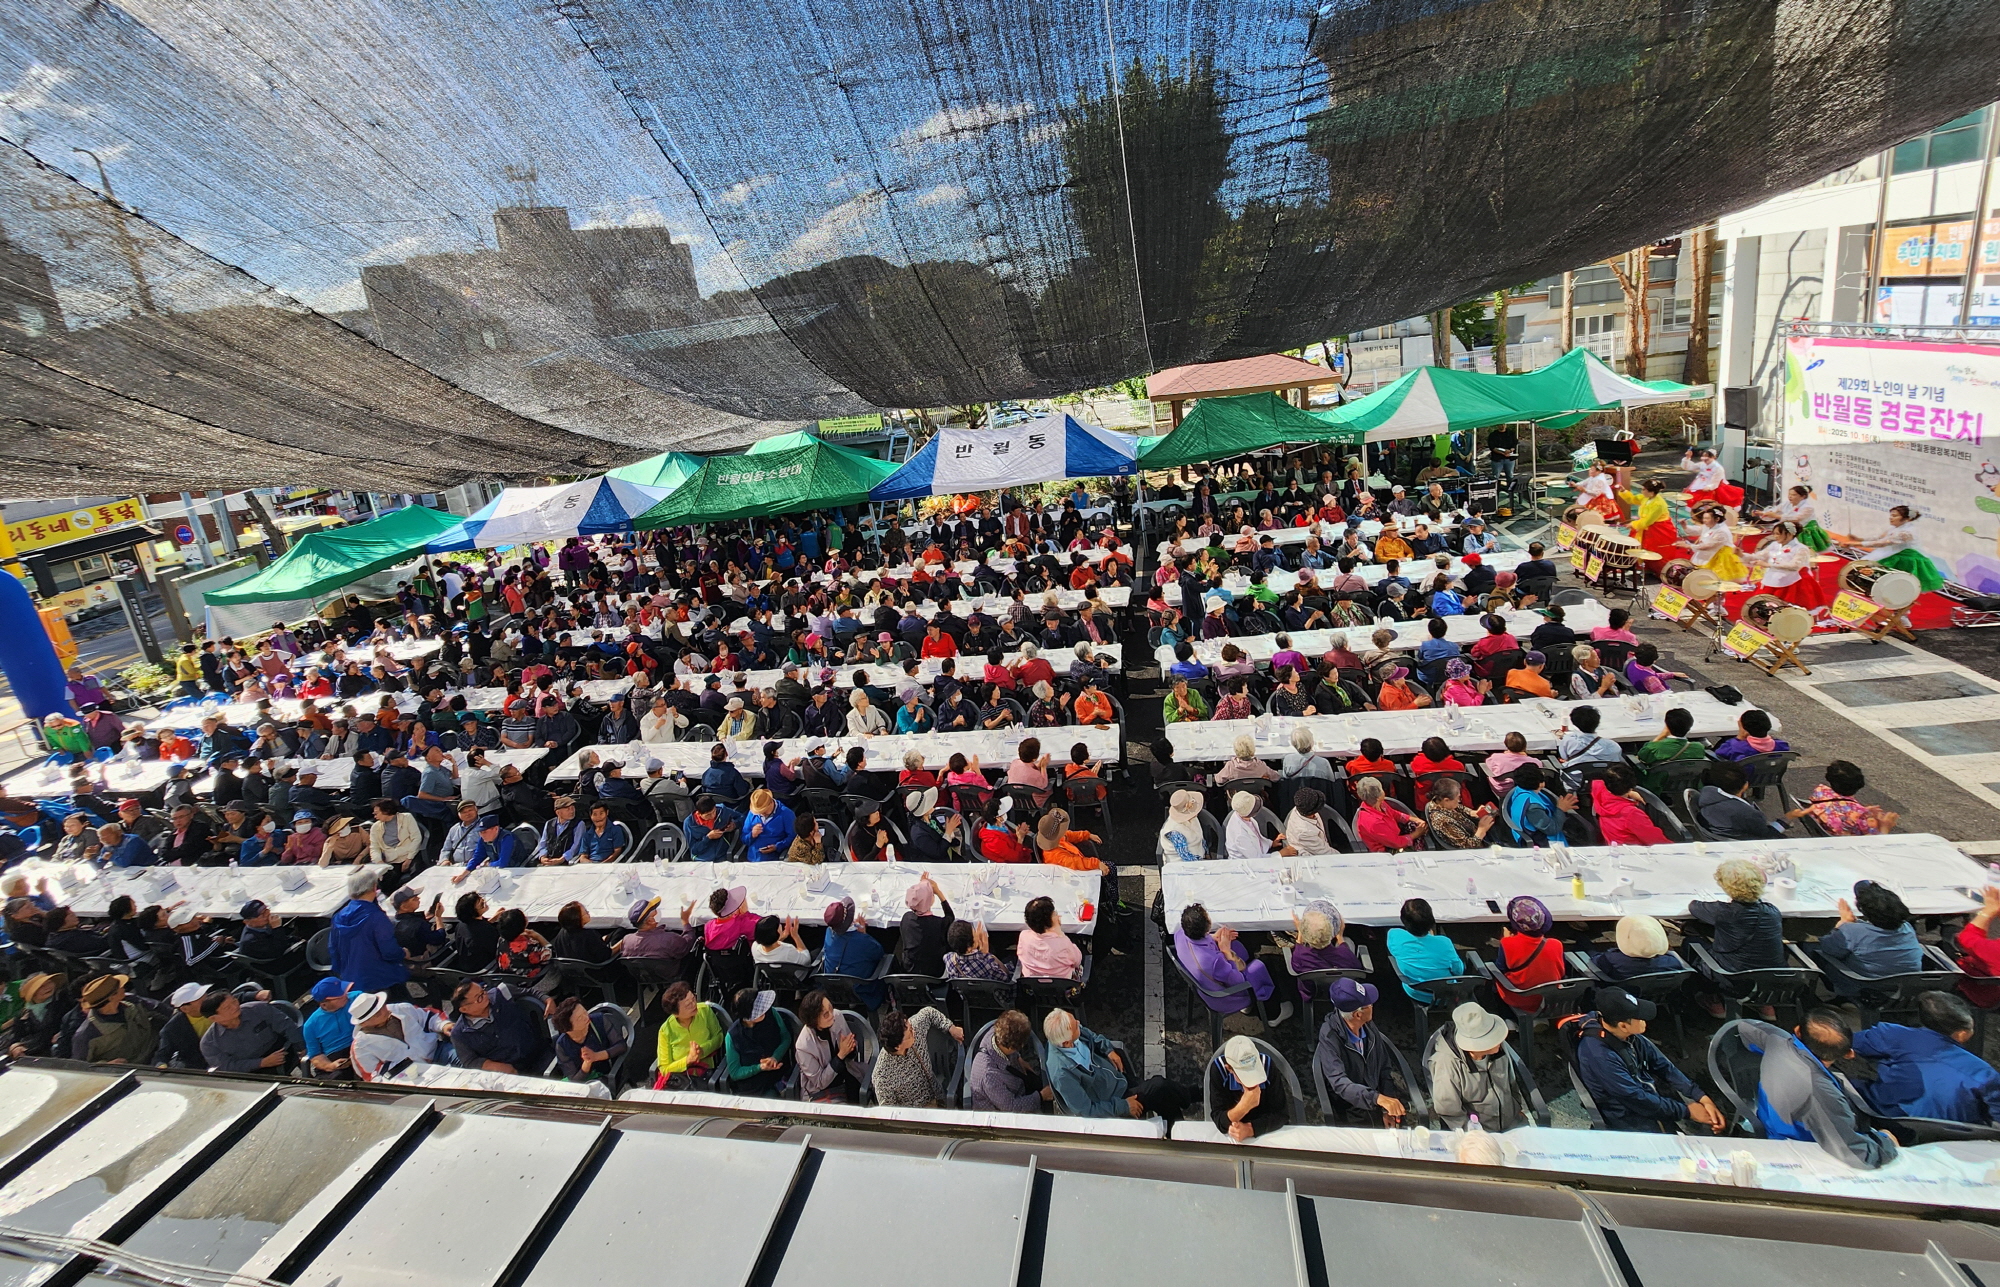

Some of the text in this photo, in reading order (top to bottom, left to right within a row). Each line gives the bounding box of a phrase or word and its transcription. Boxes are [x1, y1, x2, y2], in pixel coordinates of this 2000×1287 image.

[1898, 242, 1962, 266] 주민자치회
[1946, 292, 1985, 308] 제2회
[1838, 377, 1945, 403] 제29회 노인의 날 기념
[1813, 392, 1983, 446] 반월동 경로잔치
[1910, 442, 1972, 462] 반월동행정복지센터
[716, 463, 803, 486] 반월의용소방대
[96, 503, 136, 525] 통닭
